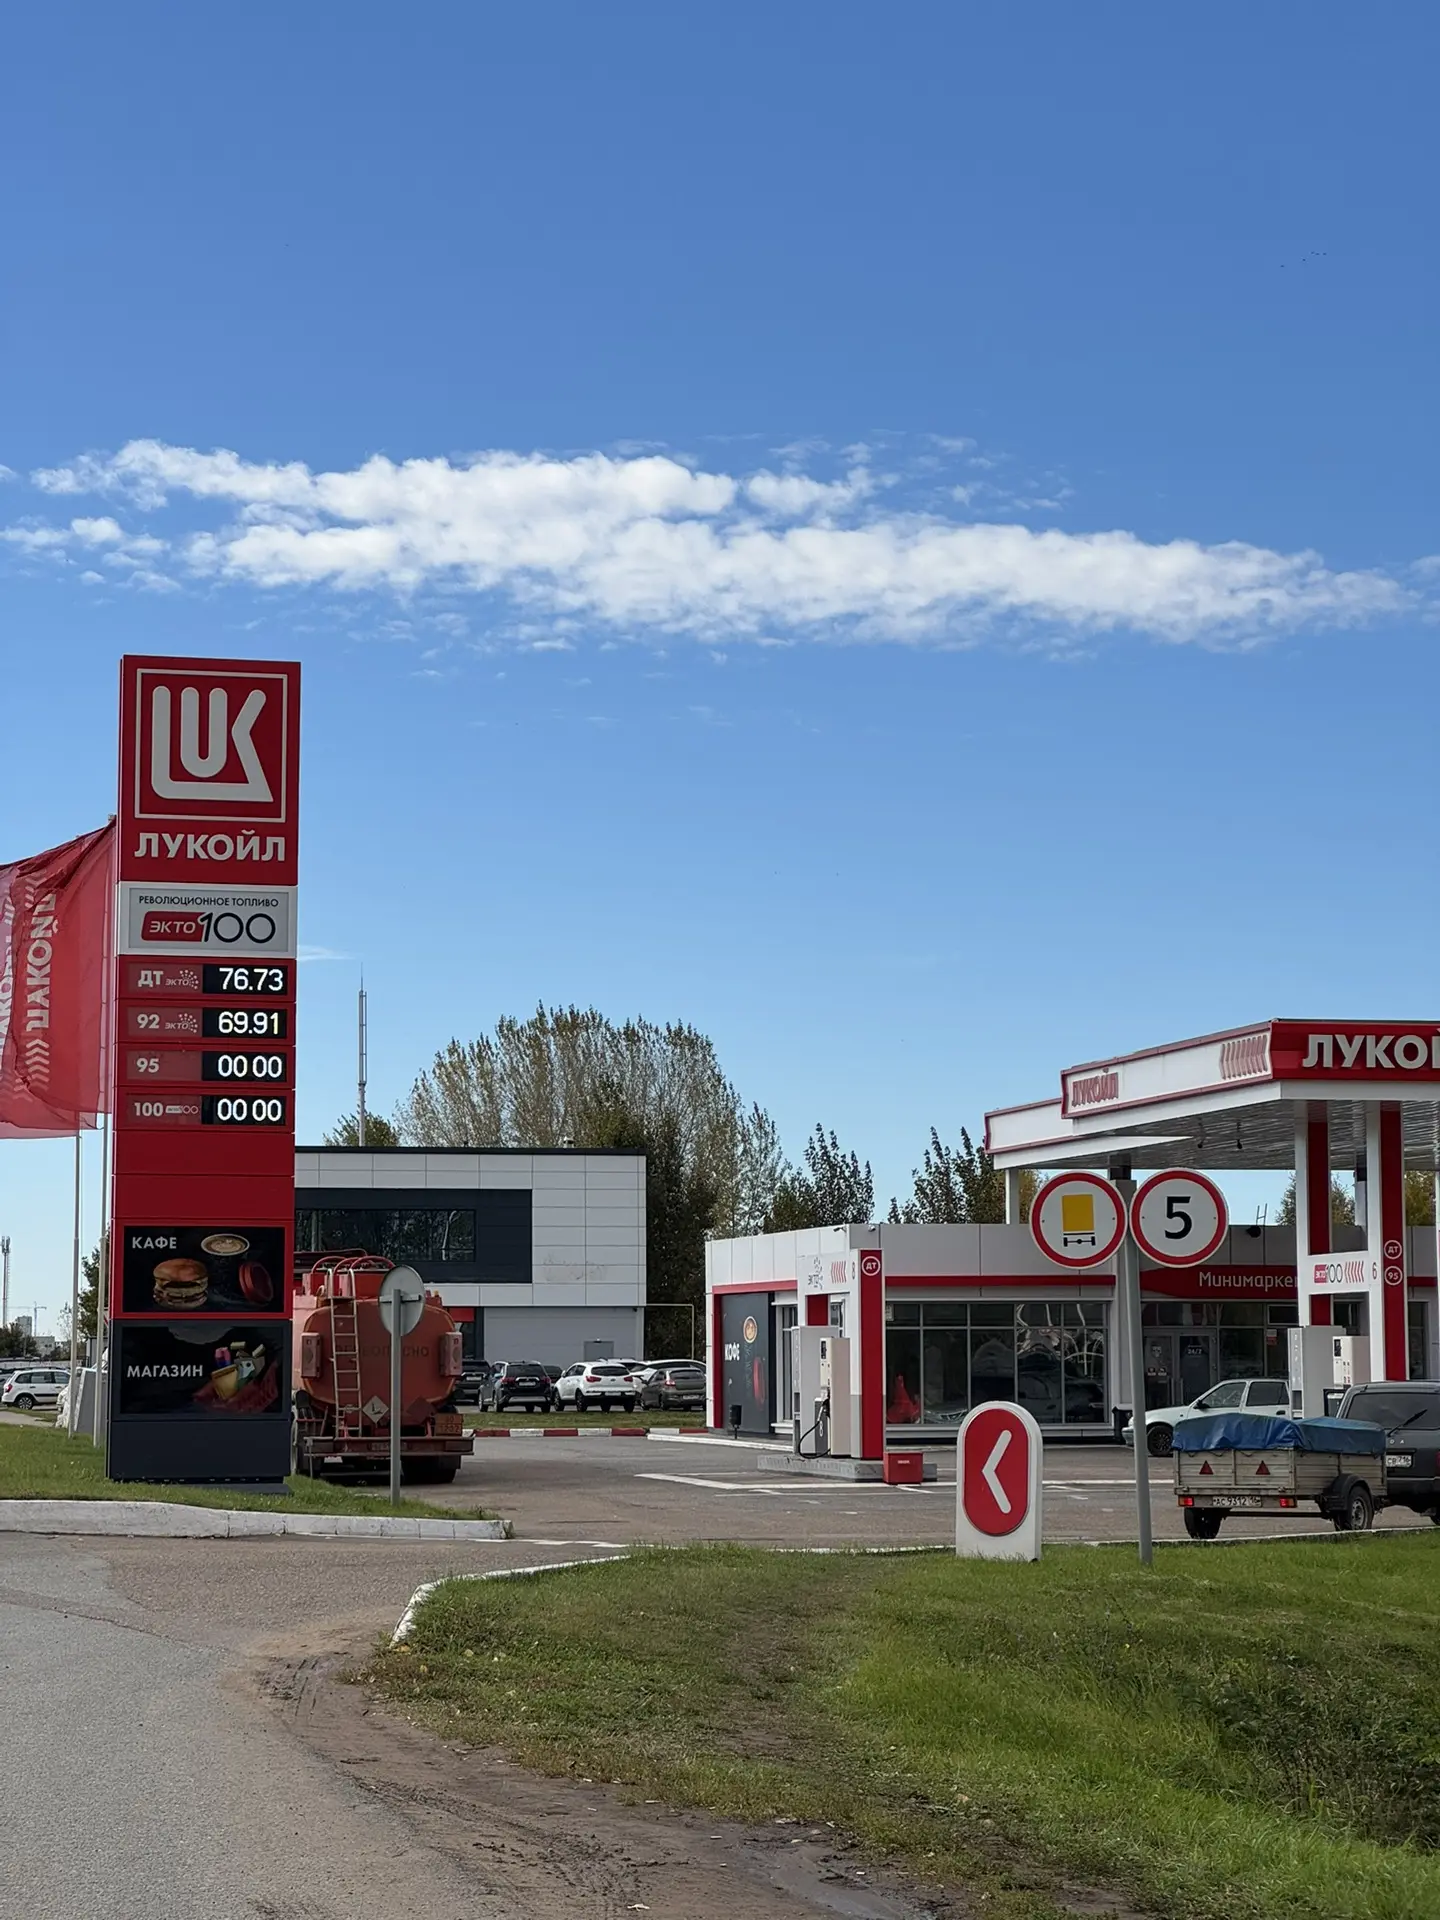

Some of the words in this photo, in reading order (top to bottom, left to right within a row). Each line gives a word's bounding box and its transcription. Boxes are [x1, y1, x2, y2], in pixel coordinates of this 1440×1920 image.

[134, 829, 286, 862] ЛУКОЙЛ
[139, 895, 229, 906] РЕВОЛЮЦИОННОЕ
[232, 897, 279, 907] ТОПЛИВО
[149, 920, 196, 934] ЭКТО
[199, 911, 276, 944] 100
[138, 970, 164, 987] ДТ
[165, 978, 189, 986] ЭКТО
[219, 967, 283, 991] 76.73
[137, 1014, 160, 1029] 92
[218, 1011, 279, 1034] 69.91
[136, 1058, 160, 1073] 95
[1072, 1067, 1119, 1107] ЛУКОЙЛ
[134, 1102, 163, 1117] 100
[1164, 1196, 1192, 1239] 5
[132, 1236, 177, 1249] КАФЕ
[1387, 1246, 1399, 1254] ДТ
[865, 1262, 877, 1270] ДТ
[1199, 1271, 1298, 1292] Минимарке
[1387, 1271, 1399, 1280] 95
[127, 1364, 204, 1378] МАГАЗИН
